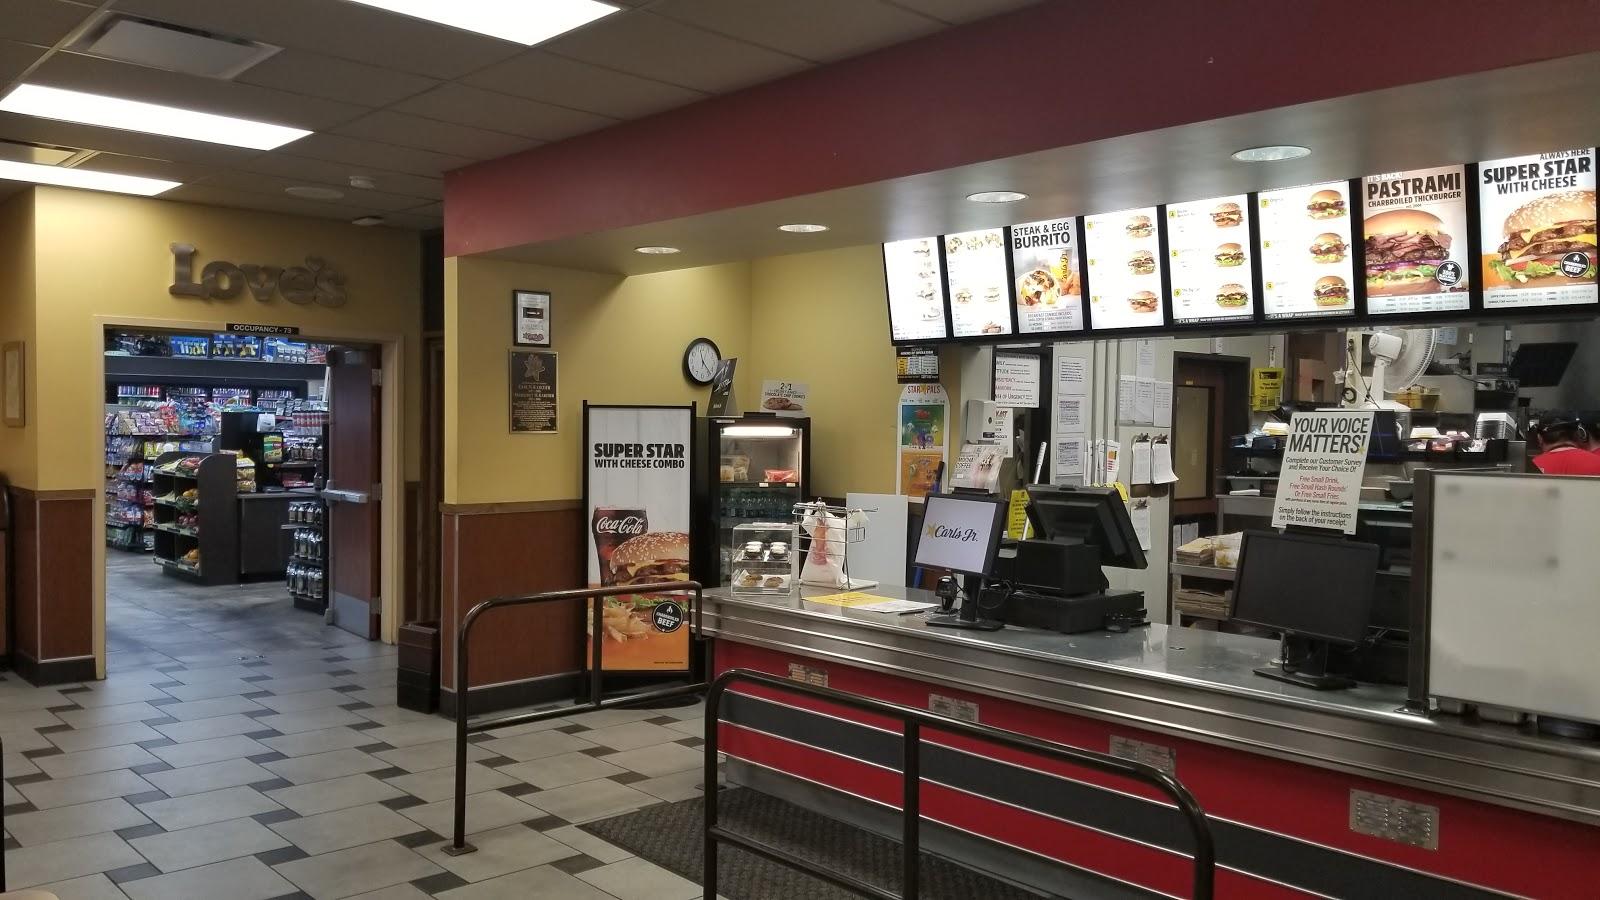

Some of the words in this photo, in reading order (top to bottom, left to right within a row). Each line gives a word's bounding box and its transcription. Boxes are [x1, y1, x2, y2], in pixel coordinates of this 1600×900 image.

[1540, 151, 1569, 160] ALWAYS
[1571, 148, 1591, 156] HERE
[1483, 163, 1541, 185] SUPER
[1544, 157, 1592, 177] STAR
[1368, 173, 1461, 200] PASTRAMI
[1497, 180, 1529, 195] WITH
[1532, 175, 1578, 191] CHEESE
[1368, 198, 1413, 208] CHARBROILED
[1414, 191, 1462, 203] THICKBURGER
[1014, 225, 1041, 237] STEAK
[1043, 224, 1050, 234] &
[1051, 222, 1070, 232] EGG
[1014, 232, 1071, 250] BURRITO
[169, 242, 348, 308] Love's
[1565, 265, 1582, 273] BEEF
[233, 324, 278, 333] OCCUPANCY
[907, 385, 921, 394] STAR
[927, 385, 941, 394] PALS
[1294, 418, 1328, 433] YOUR
[1331, 418, 1370, 433] VOICE
[594, 443, 643, 458] SUPER
[646, 443, 684, 458] STAR
[1288, 434, 1367, 454] MATTERS!
[595, 459, 618, 468] WITH
[620, 459, 651, 468] CHEESE
[653, 459, 685, 468] COMBO
[1345, 459, 1362, 467] Survey
[1321, 511, 1351, 519] instructions
[935, 525, 961, 539] Carl's
[962, 528, 978, 541] Jr.
[657, 618, 675, 628] BEEF
